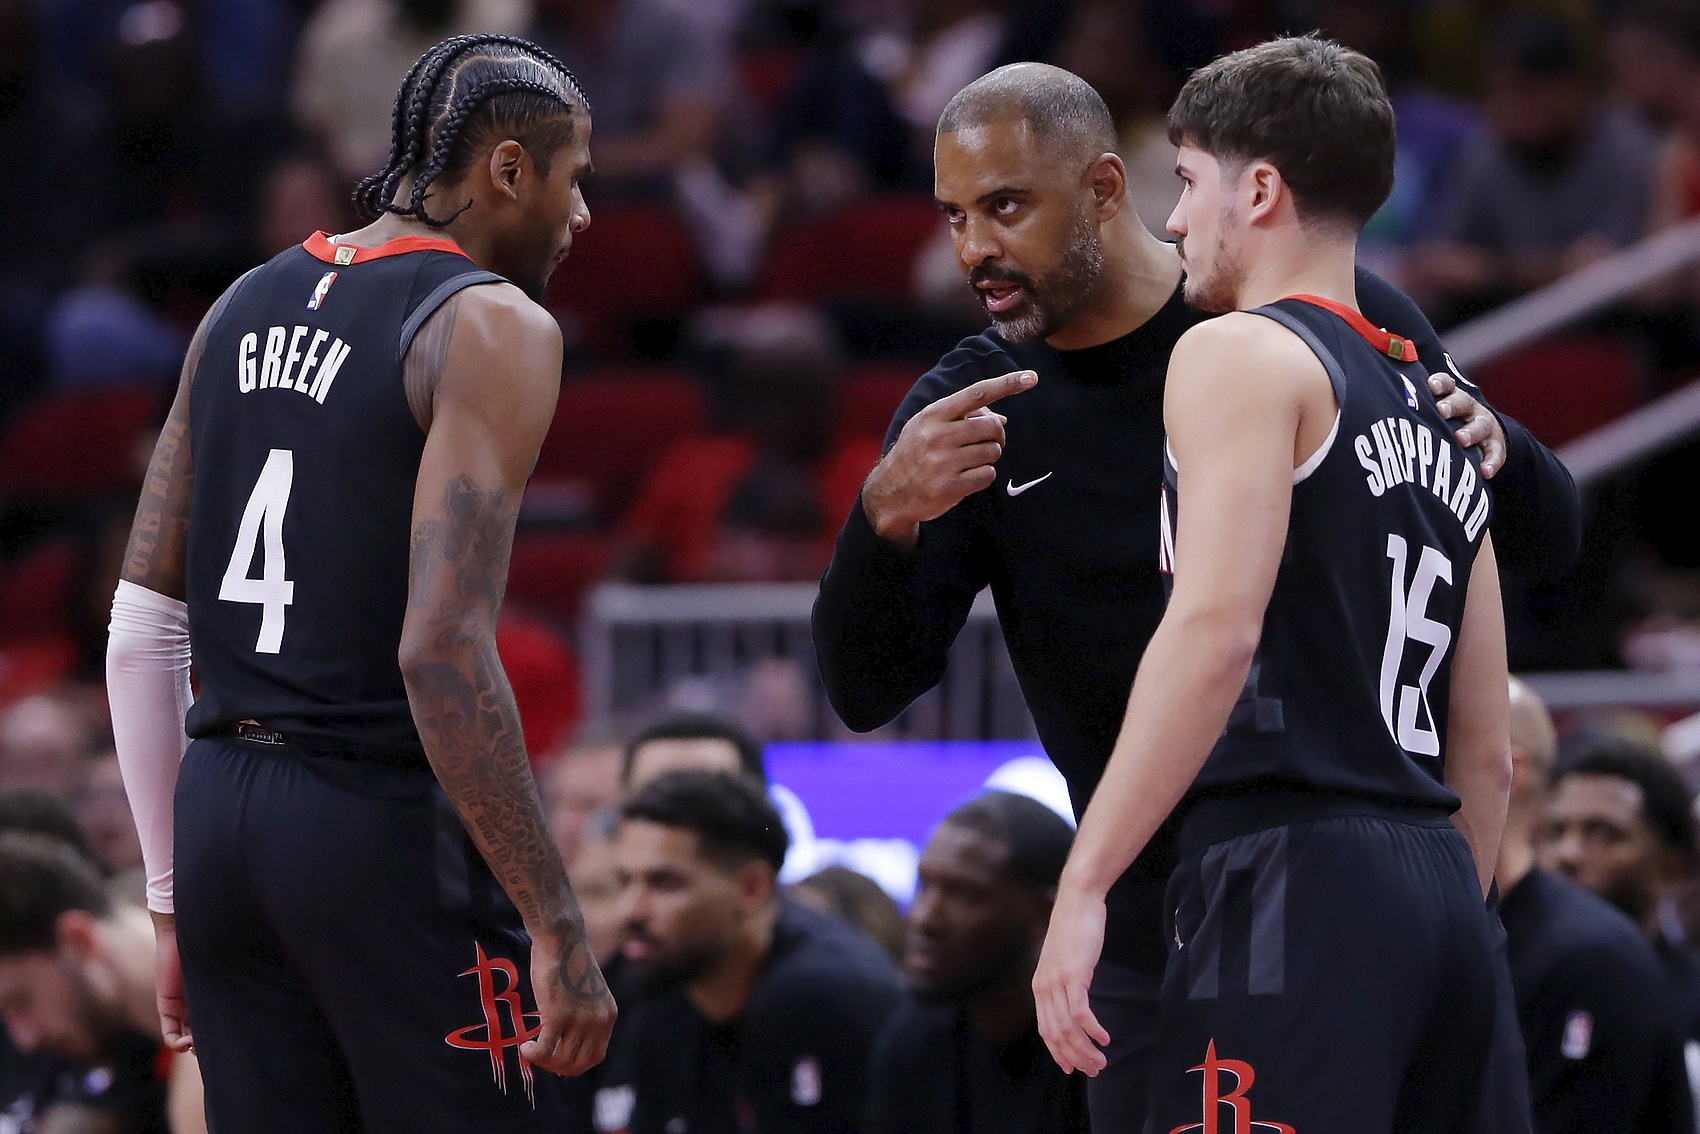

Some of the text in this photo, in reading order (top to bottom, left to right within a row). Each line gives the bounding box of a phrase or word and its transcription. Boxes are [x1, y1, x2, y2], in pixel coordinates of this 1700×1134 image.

[238, 325, 352, 405] GREEN
[1354, 417, 1490, 543] SHEPPARD
[218, 449, 295, 654] 4
[1380, 533, 1453, 757] 15
[475, 813, 512, 865] world
